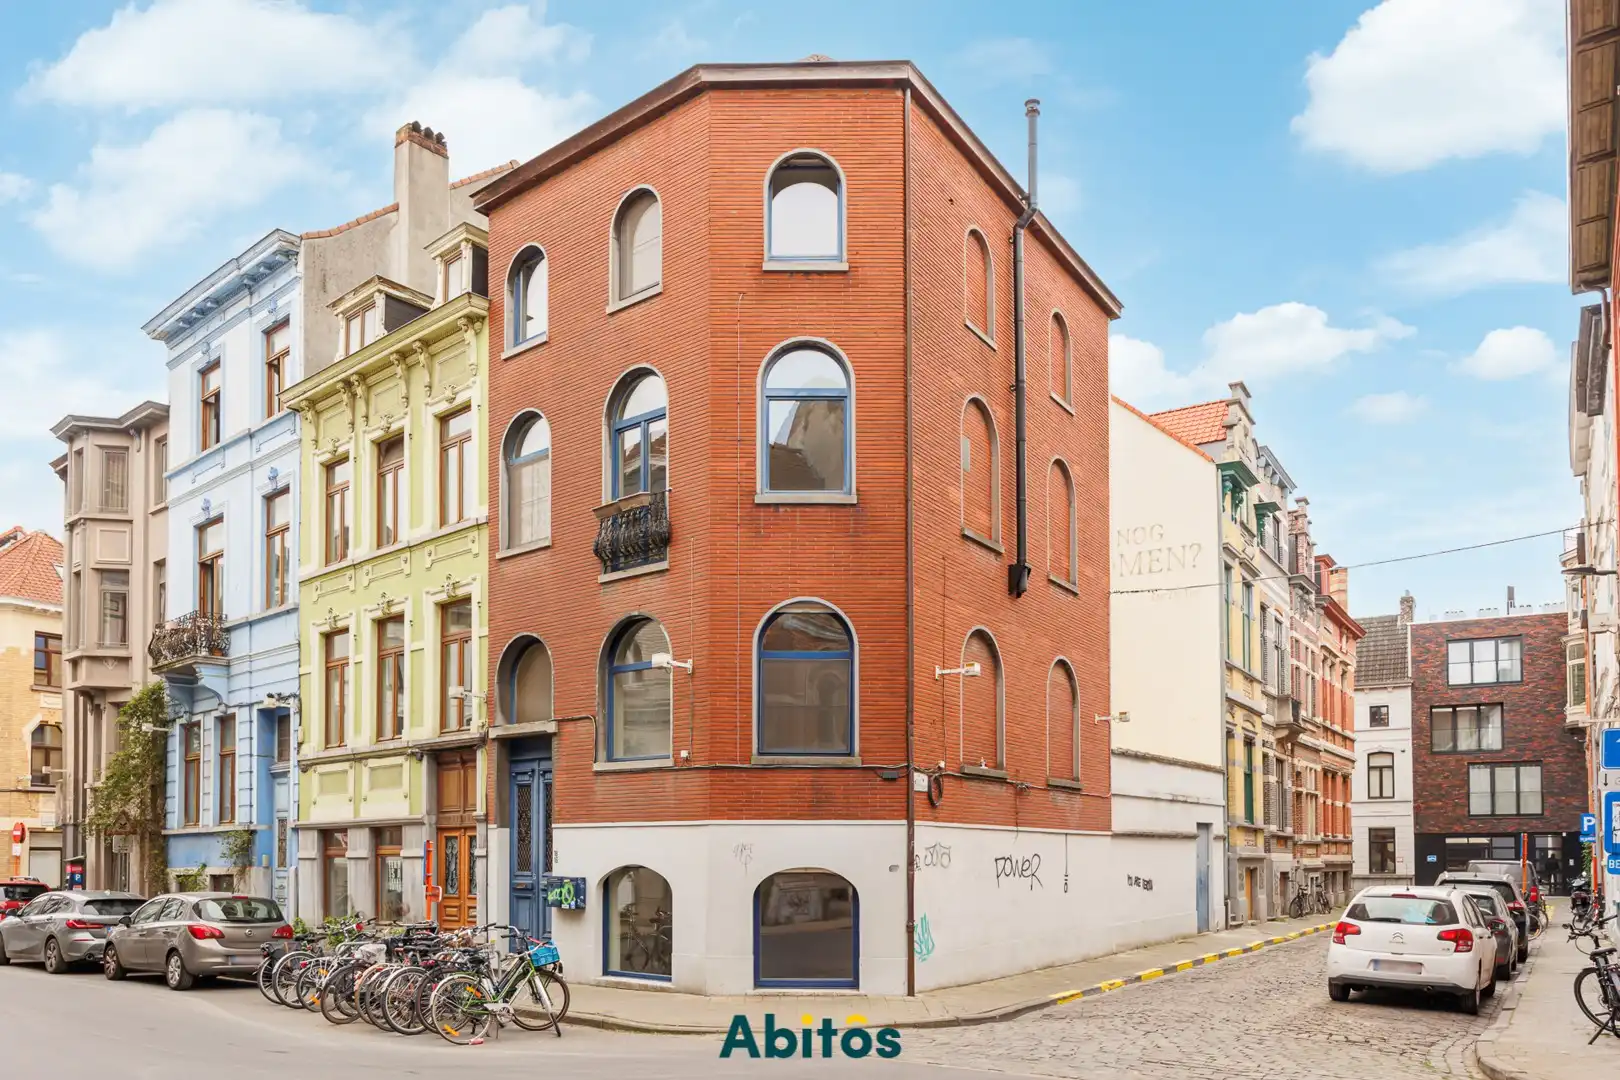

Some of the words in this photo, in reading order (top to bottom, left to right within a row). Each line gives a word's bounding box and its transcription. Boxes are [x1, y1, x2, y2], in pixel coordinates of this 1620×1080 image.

[1116, 523, 1164, 548] NOG
[1112, 542, 1201, 578] MEN?
[1583, 816, 1595, 832] P
